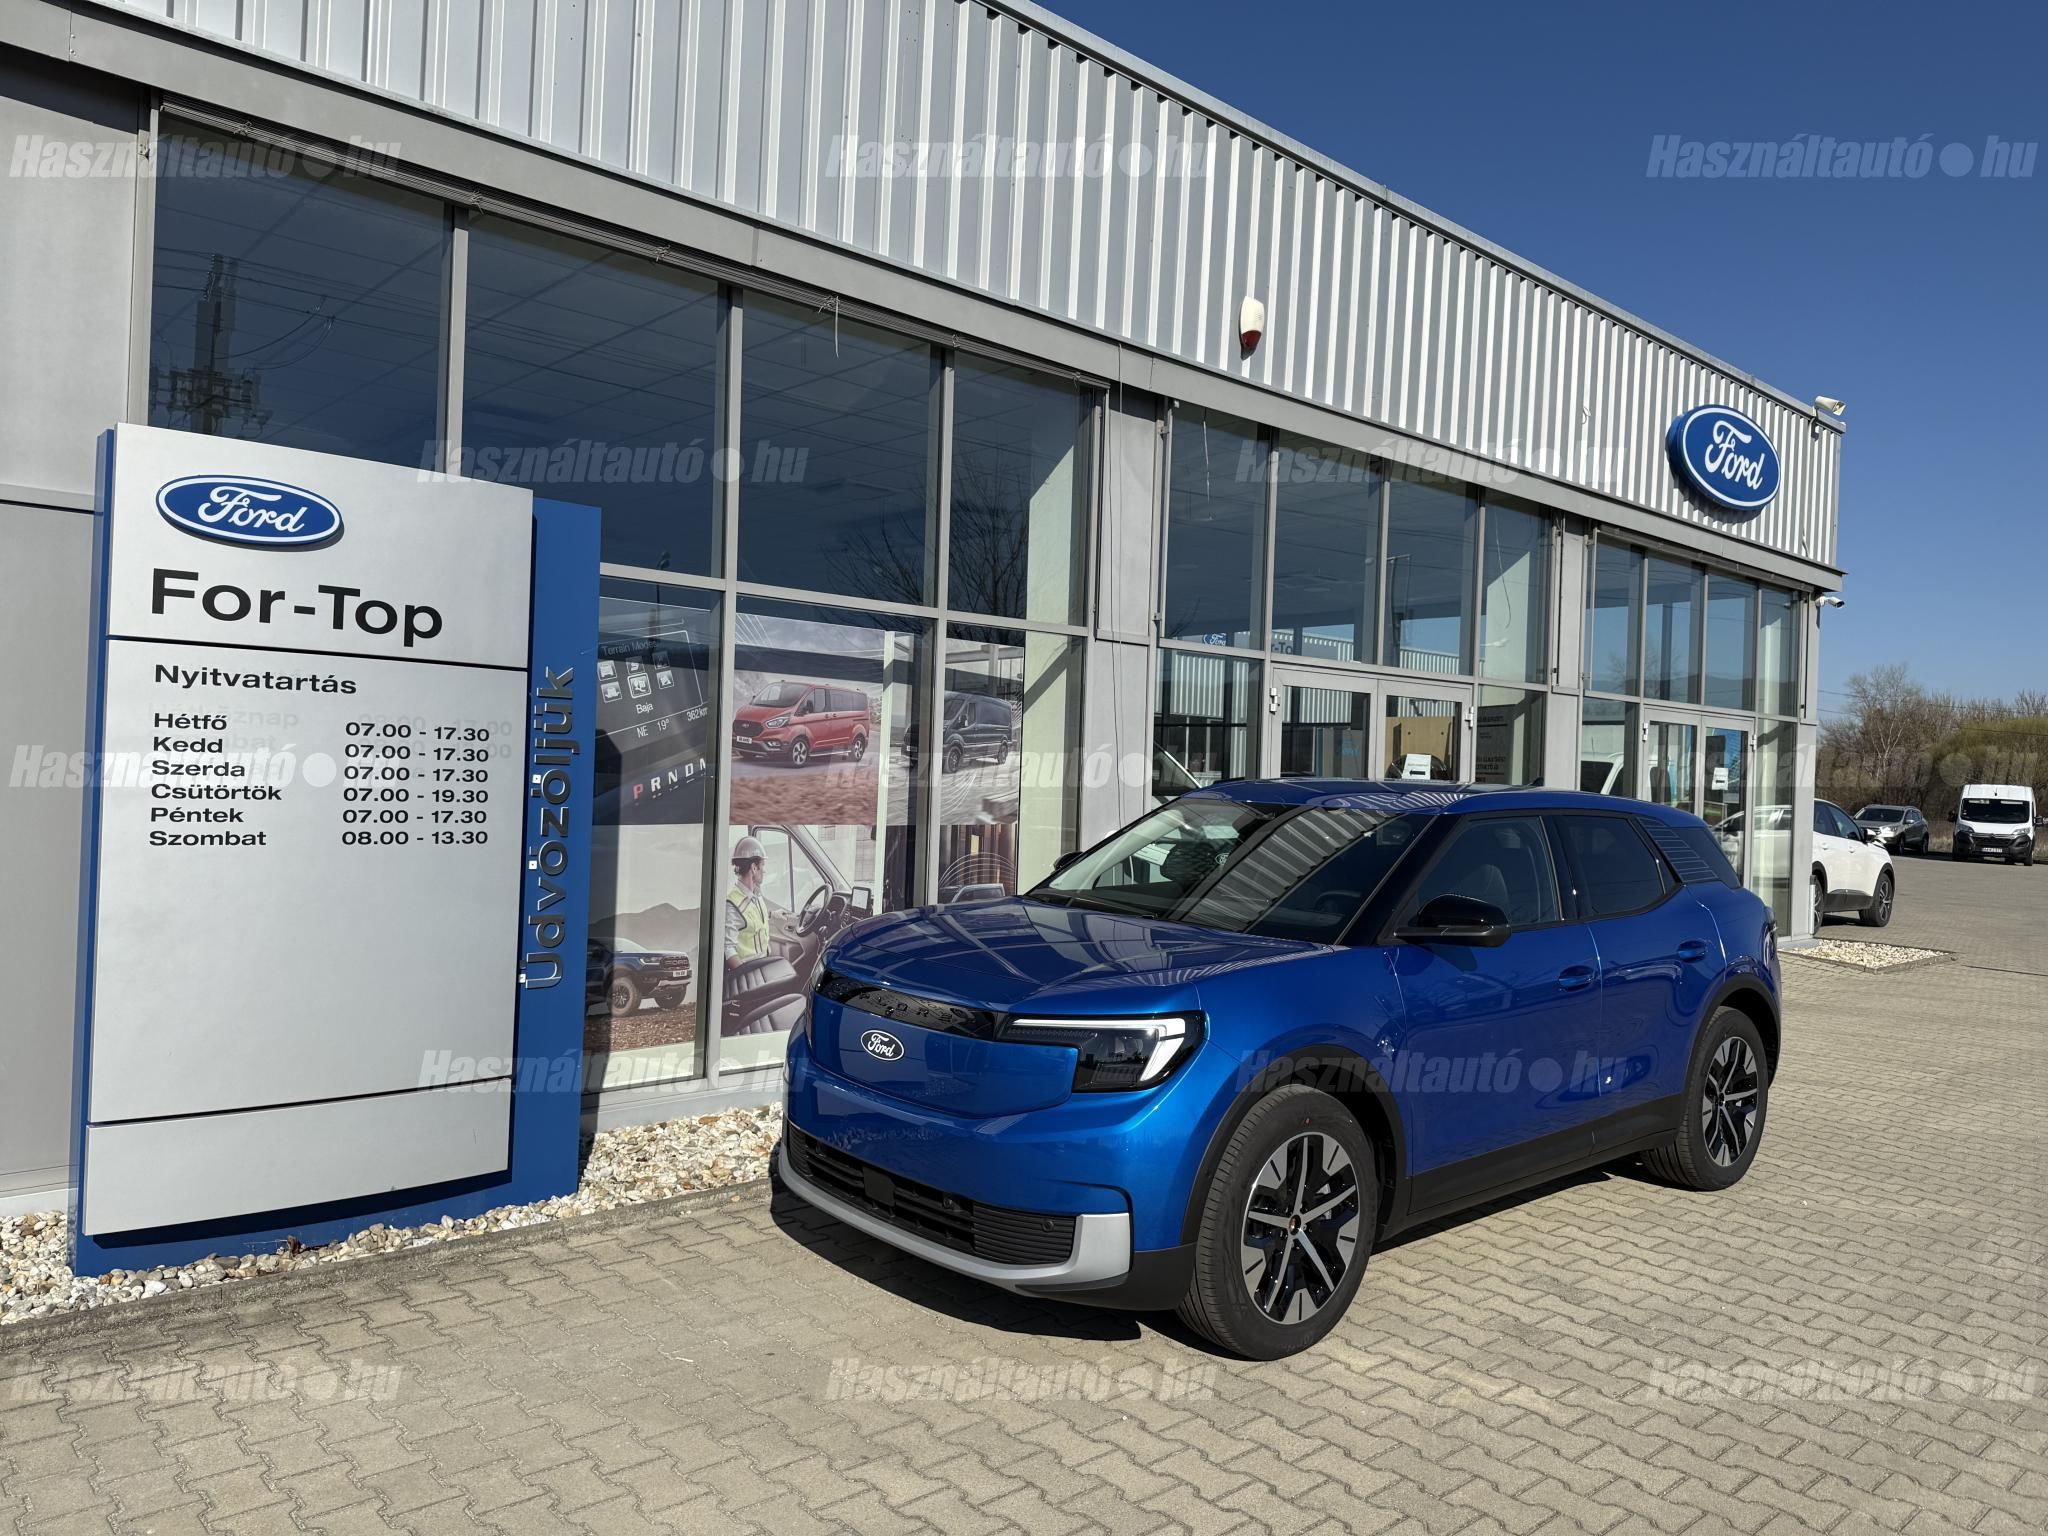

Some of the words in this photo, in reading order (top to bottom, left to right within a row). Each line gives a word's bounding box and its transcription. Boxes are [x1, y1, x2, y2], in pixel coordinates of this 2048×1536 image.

[1705, 420, 1765, 490] Ford
[198, 486, 308, 533] Ford
[152, 568, 442, 647] For-Top
[155, 665, 357, 695] Nyitvatartás
[636, 702, 654, 714] Baja
[155, 713, 227, 731] Hétfő
[346, 722, 412, 738] 07.00
[435, 727, 490, 741] 17.30
[637, 725, 649, 738] NE
[153, 737, 223, 753] Kedd
[345, 744, 411, 760] 07.00
[433, 748, 489, 762] 17.30
[152, 760, 245, 777] Szerda
[345, 766, 410, 781] 07.00
[433, 768, 488, 782] 17.30
[651, 777, 661, 792] R
[668, 769, 678, 784] N
[685, 763, 694, 777] D
[151, 784, 282, 800] Csütörtök
[344, 788, 409, 802] 07.00
[432, 790, 488, 803] 19.30
[151, 808, 244, 823] Péntek
[343, 810, 409, 824] 07.00
[432, 811, 487, 824] 17.30
[519, 666, 580, 990] Üdvözöljük
[150, 831, 266, 846] Szombat
[342, 831, 409, 846] 08.00
[432, 831, 488, 845] 13.30
[868, 1033, 895, 1057] Ford
